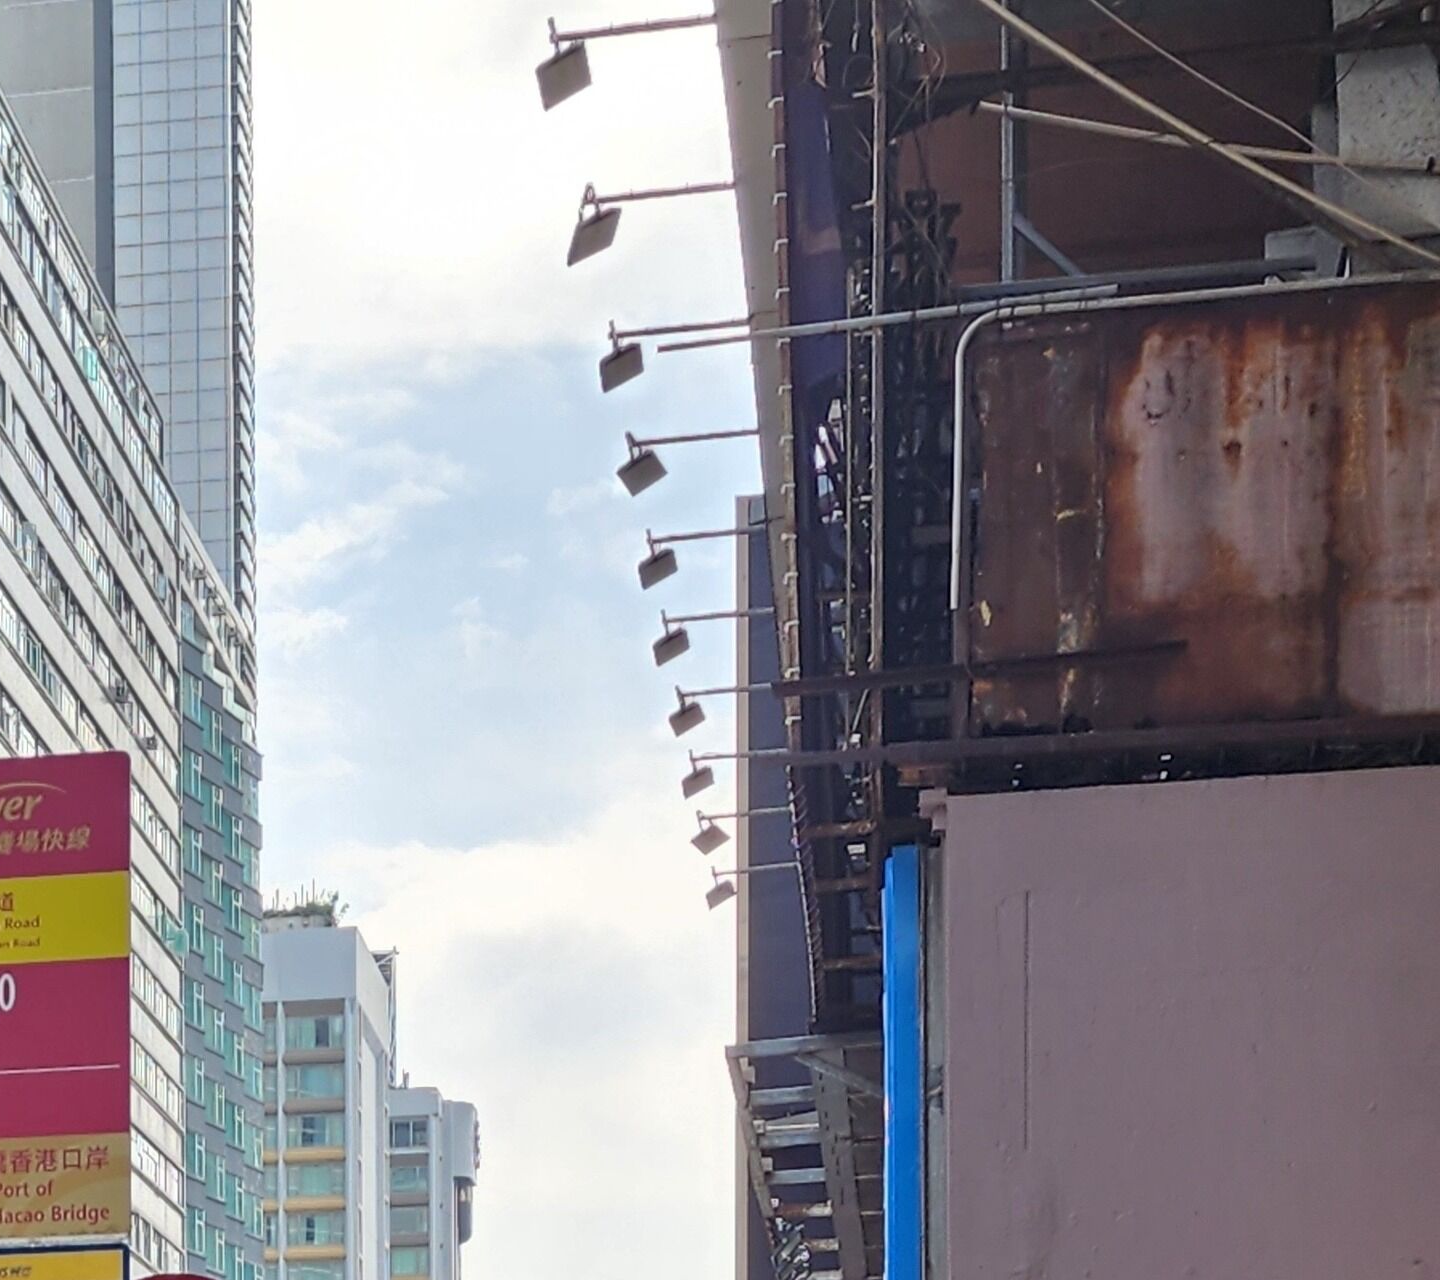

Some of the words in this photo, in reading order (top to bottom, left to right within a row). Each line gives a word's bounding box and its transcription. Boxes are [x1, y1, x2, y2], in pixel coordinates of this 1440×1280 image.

[4, 914, 41, 929] Road
[13, 937, 41, 948] Road
[35, 1179, 55, 1197] of
[51, 1203, 111, 1225] Bridge
